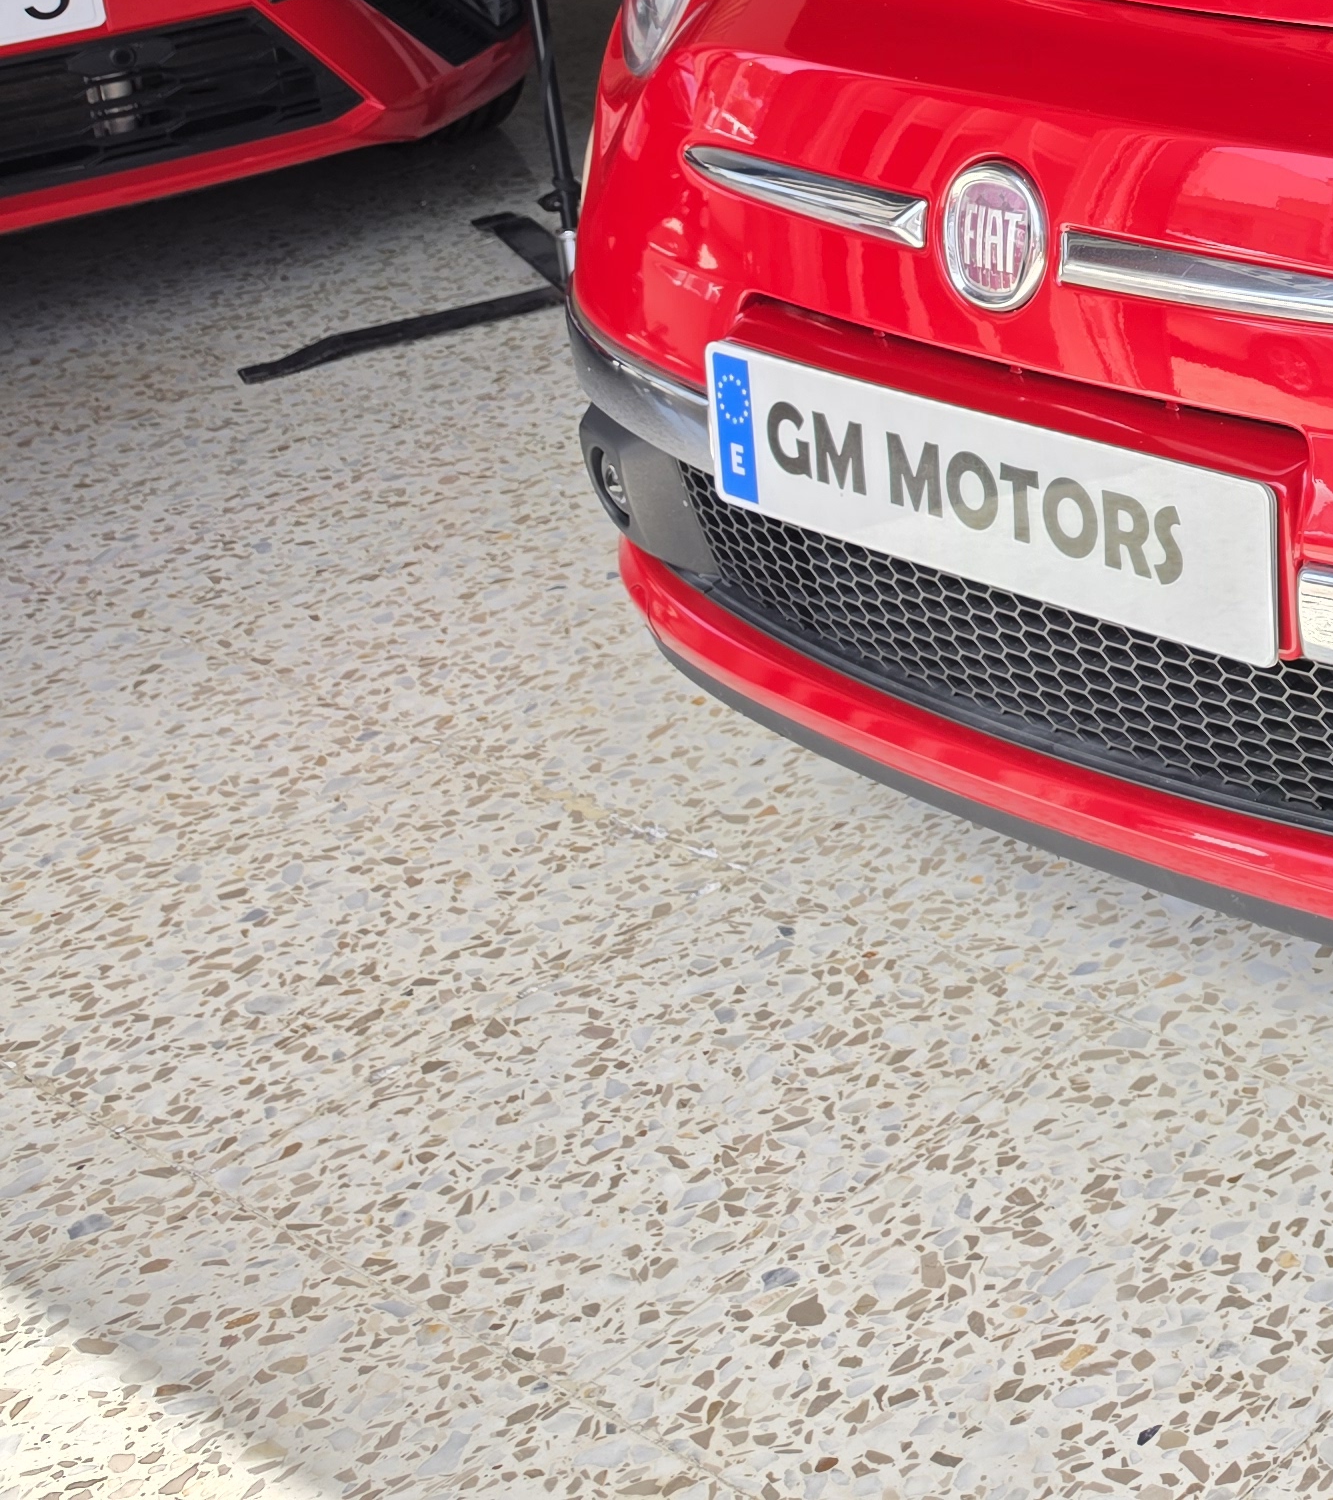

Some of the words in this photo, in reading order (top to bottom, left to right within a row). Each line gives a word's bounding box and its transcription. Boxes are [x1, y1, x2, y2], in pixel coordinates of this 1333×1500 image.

[963, 202, 1024, 274] FIAT
[729, 442, 746, 476] E
[766, 401, 867, 496] GM
[884, 430, 1184, 586] MOTORS
